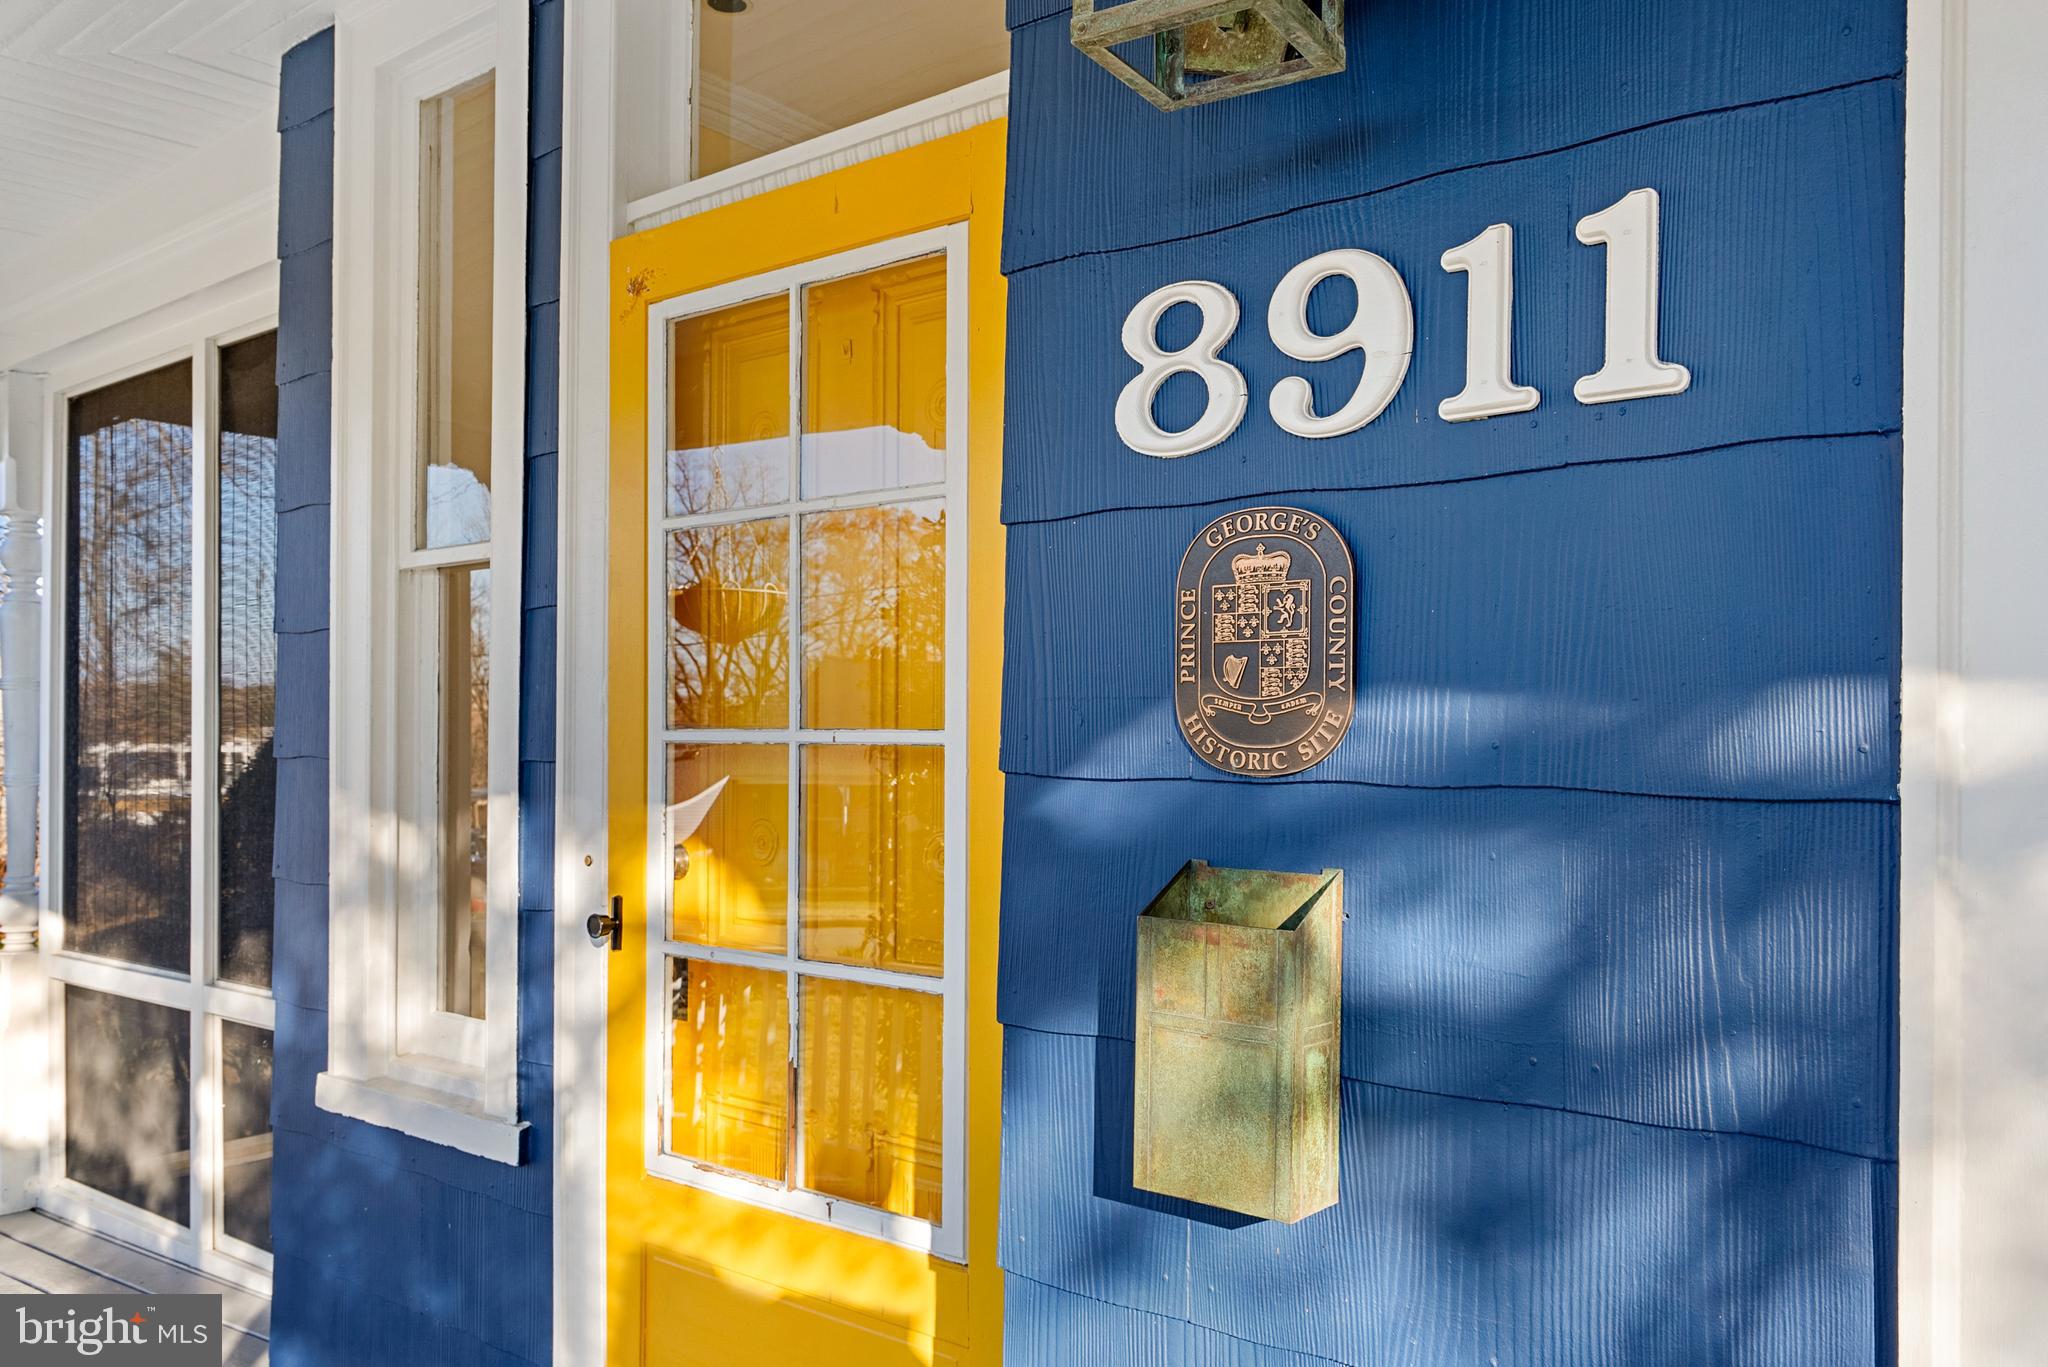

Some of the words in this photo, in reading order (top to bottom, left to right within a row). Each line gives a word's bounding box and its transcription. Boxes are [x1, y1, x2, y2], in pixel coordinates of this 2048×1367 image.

[1115, 187, 1691, 459] 8911
[1180, 588, 1197, 684] PRINCE
[1206, 512, 1322, 548] GEORGE'S
[1328, 575, 1347, 692] COUNTY
[1184, 713, 1288, 771] HISTORIC
[1297, 709, 1345, 762] SITE
[1214, 698, 1242, 711] SEMPER
